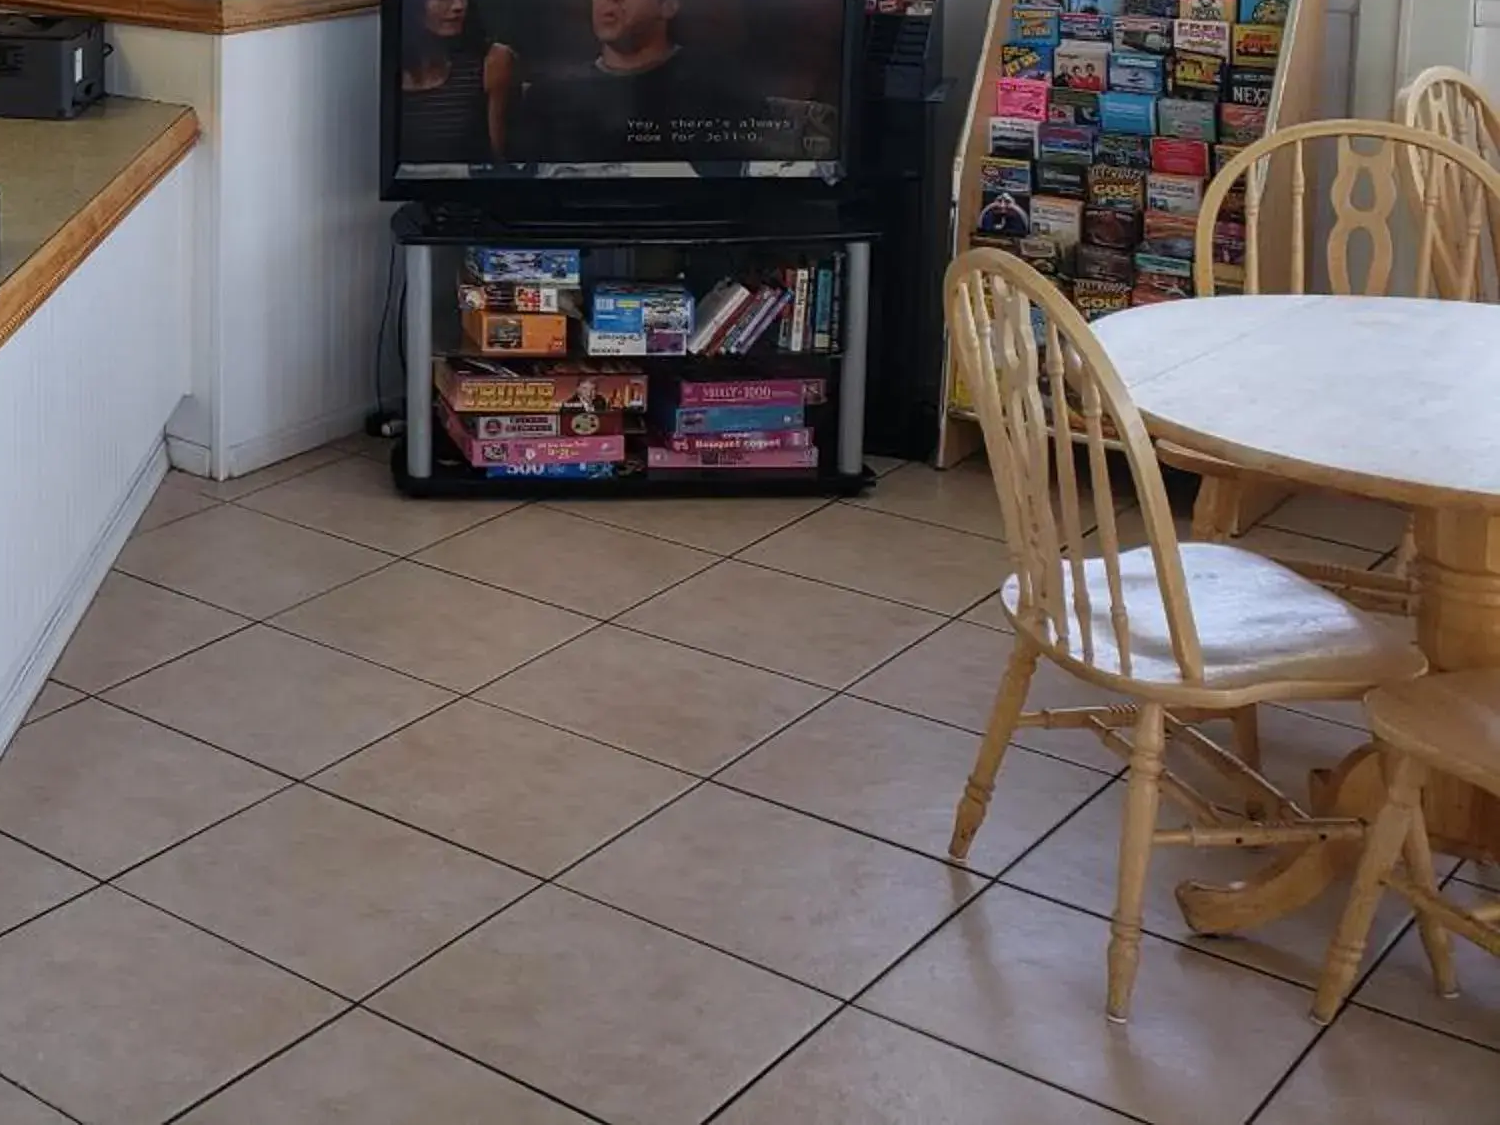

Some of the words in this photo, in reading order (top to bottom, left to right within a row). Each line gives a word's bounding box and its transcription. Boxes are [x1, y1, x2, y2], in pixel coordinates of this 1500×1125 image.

[671, 118, 731, 129] there's
[739, 118, 791, 131] always
[627, 132, 662, 142] room
[671, 131, 694, 142] for
